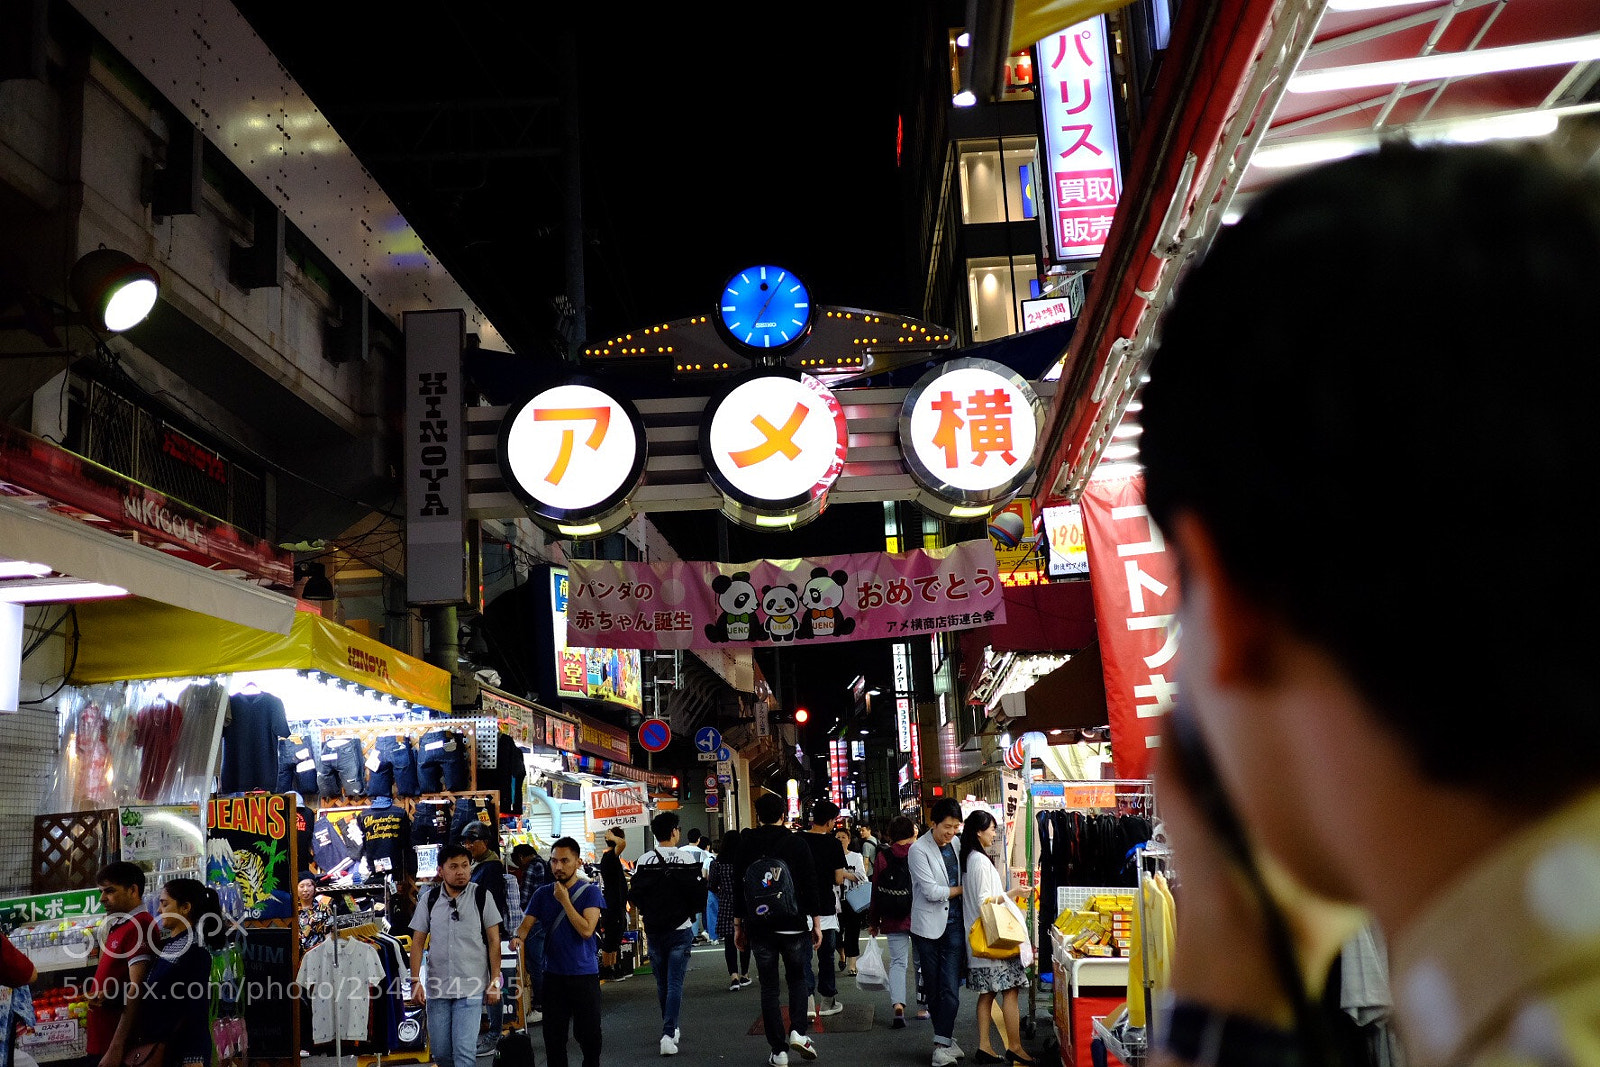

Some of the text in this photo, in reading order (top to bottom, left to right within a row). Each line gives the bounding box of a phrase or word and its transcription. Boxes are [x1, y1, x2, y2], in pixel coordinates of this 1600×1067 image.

[1052, 30, 1103, 158] パリス
[1059, 177, 1114, 204] 買取
[1062, 215, 1110, 242] 販売
[418, 372, 449, 516] HINOYA
[577, 580, 653, 601] パンダの
[857, 568, 995, 610] おめでとう
[575, 611, 693, 632] 赤ちゃん誕生
[727, 626, 750, 635] UENO
[772, 623, 793, 632] UENO
[813, 621, 834, 630] UENO
[886, 610, 995, 633] アメ横商店街連合会
[347, 646, 389, 679] HINOYA
[593, 788, 642, 809] LONDON
[208, 796, 285, 840] JEANS
[601, 816, 637, 826] マルセル店
